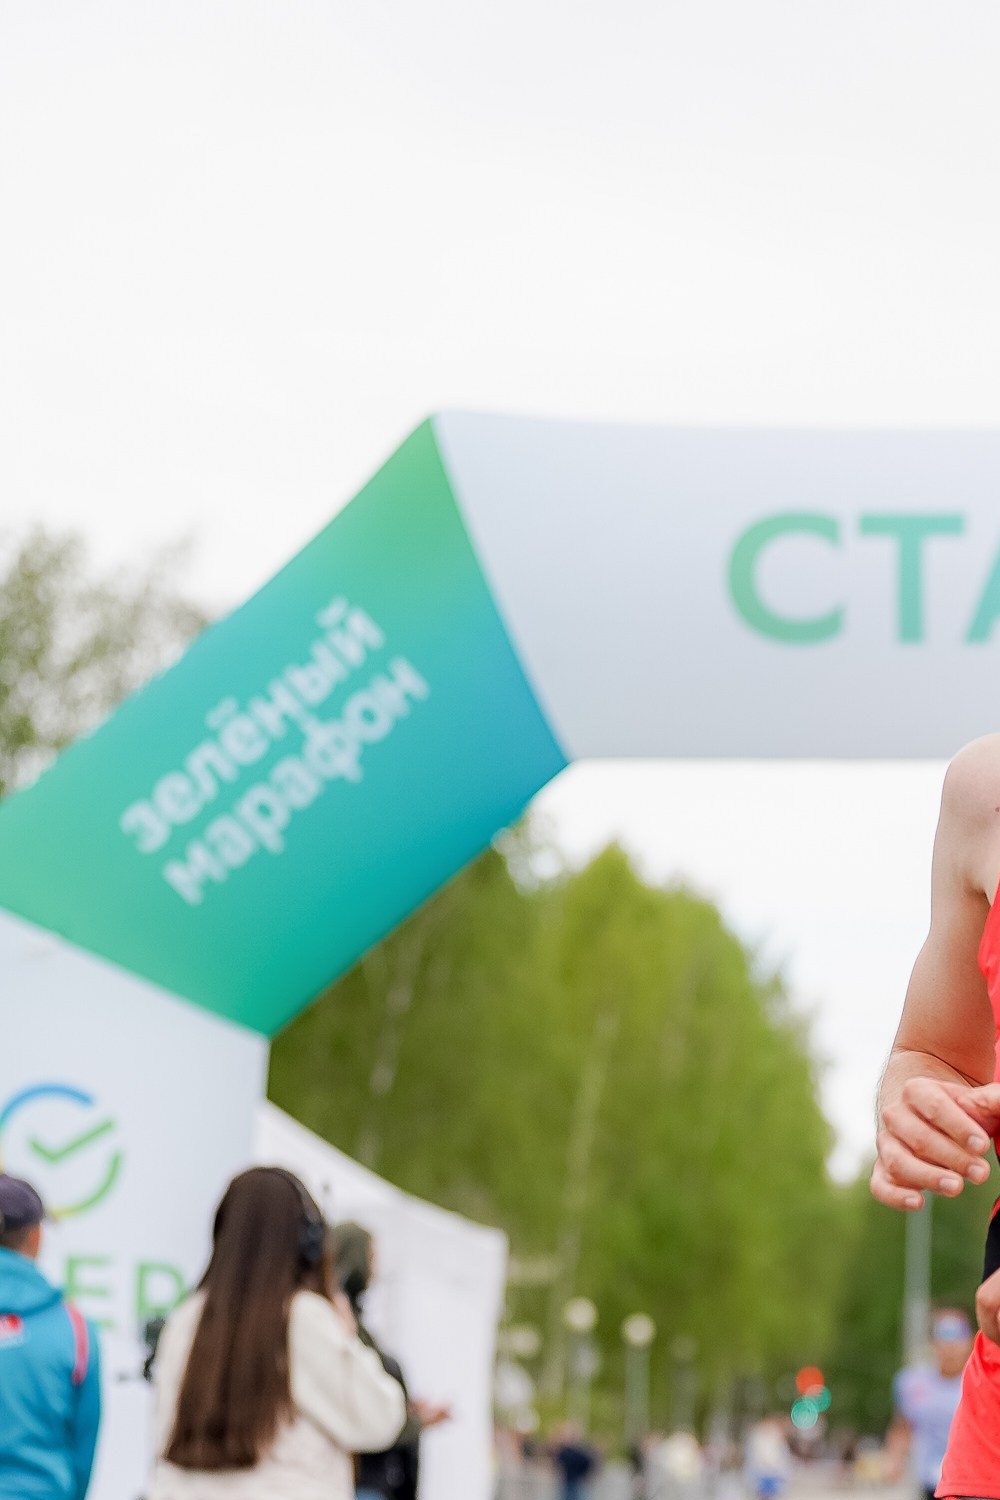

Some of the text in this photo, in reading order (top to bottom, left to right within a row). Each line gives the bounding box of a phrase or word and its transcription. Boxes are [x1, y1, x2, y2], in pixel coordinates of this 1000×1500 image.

[121, 597, 386, 853] зелёный
[163, 656, 429, 906] марафон
[64, 1255, 190, 1330] ЕР
